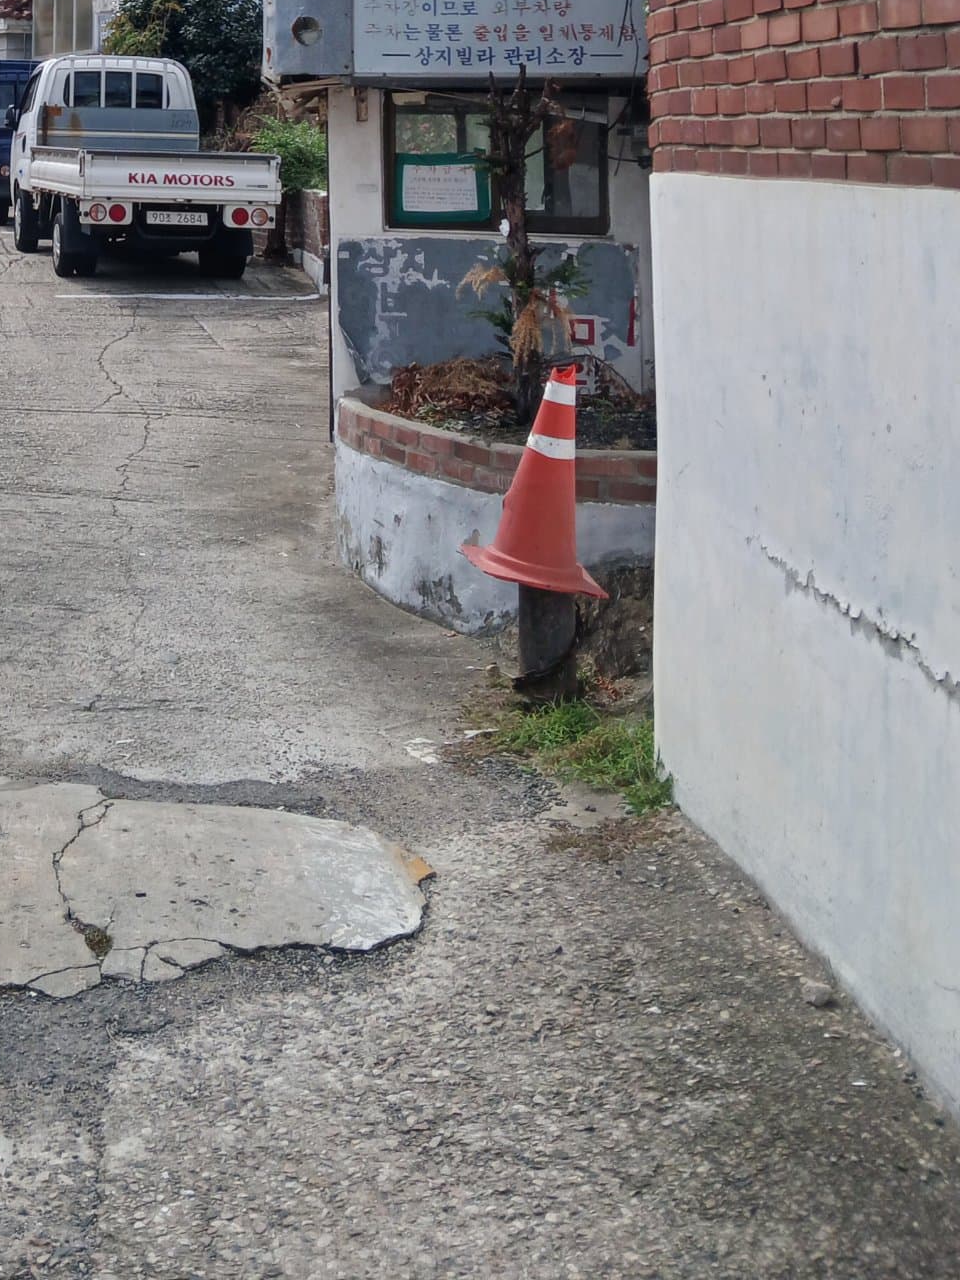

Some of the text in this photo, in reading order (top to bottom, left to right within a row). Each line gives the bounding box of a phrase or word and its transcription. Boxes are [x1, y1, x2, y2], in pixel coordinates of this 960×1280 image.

[492, 0, 572, 17] 외부차량
[472, 23, 531, 42] 출입을
[415, 46, 588, 67] 상지빌라 관리소장
[128, 172, 235, 187] KIA MOTORS
[176, 214, 203, 224] 2684
